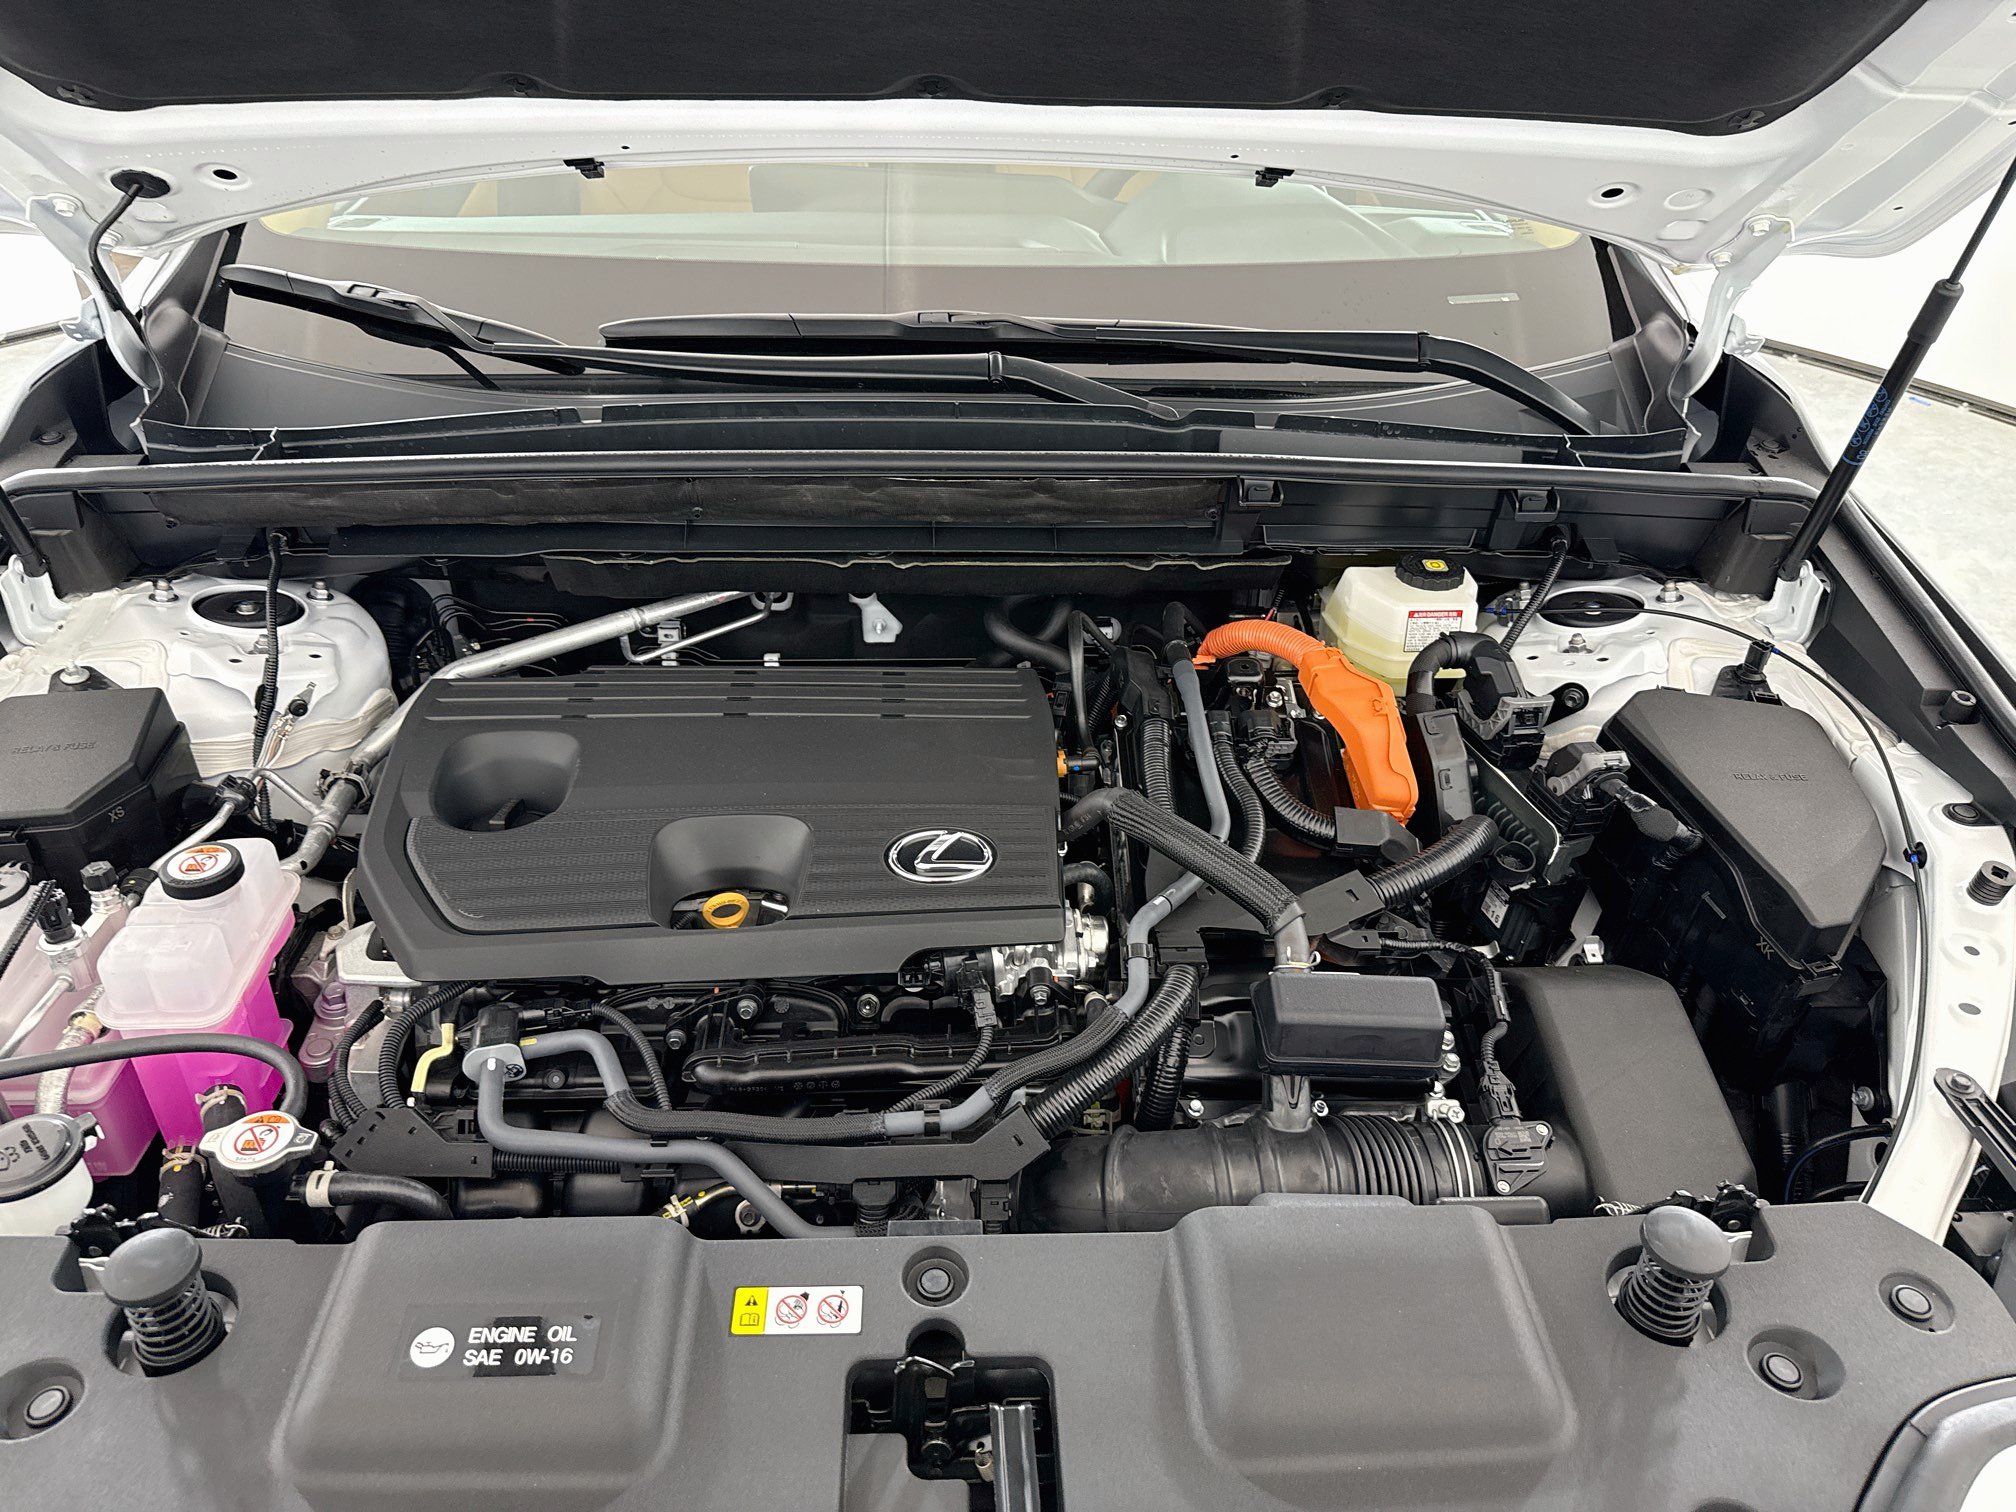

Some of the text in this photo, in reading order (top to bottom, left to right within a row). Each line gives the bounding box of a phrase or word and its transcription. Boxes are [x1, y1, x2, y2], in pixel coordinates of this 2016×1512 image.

[1778, 773, 1809, 782] FUSE
[108, 806, 126, 823] XS
[468, 1325, 578, 1344] ENGINE OIL
[462, 1347, 574, 1366] SAE 0W-16
